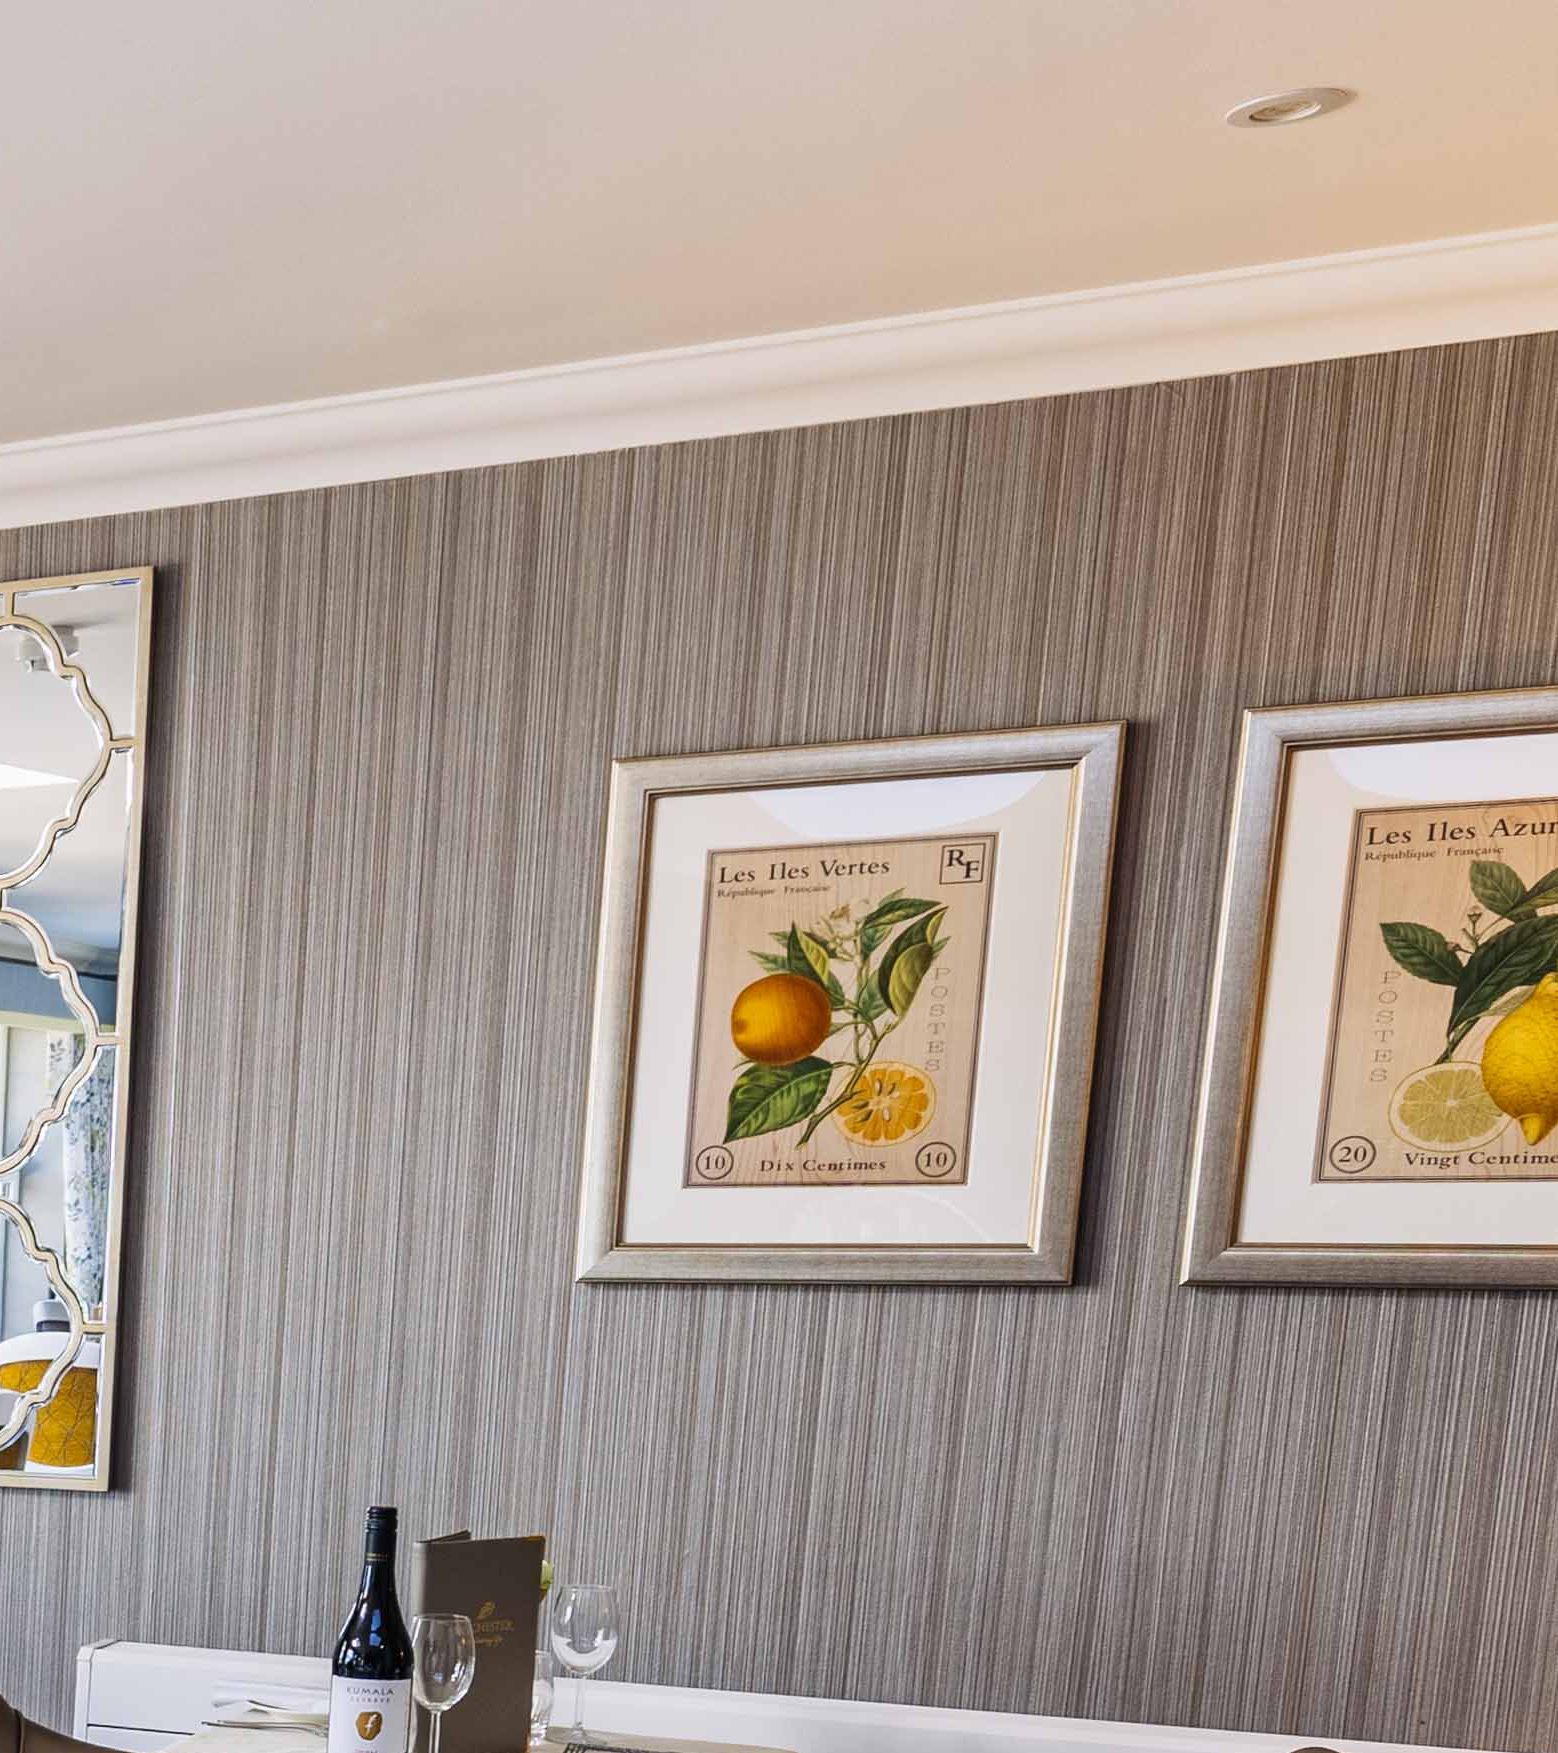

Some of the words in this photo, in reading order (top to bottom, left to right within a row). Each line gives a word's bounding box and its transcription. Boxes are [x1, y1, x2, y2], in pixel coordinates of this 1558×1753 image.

[1366, 826, 1411, 846] Les
[1426, 821, 1476, 841] Iles
[1364, 848, 1436, 862] République
[719, 866, 756, 884] Les
[768, 862, 810, 881] Iles
[819, 859, 891, 877] Vertes
[703, 1154, 726, 1171] 10
[924, 1151, 948, 1168] 10
[1338, 1146, 1367, 1162] 20
[1405, 1152, 1460, 1169] Vingt
[760, 1159, 794, 1172] Dix
[802, 1158, 887, 1173] Centimes
[347, 1687, 394, 1696] KUMALA
